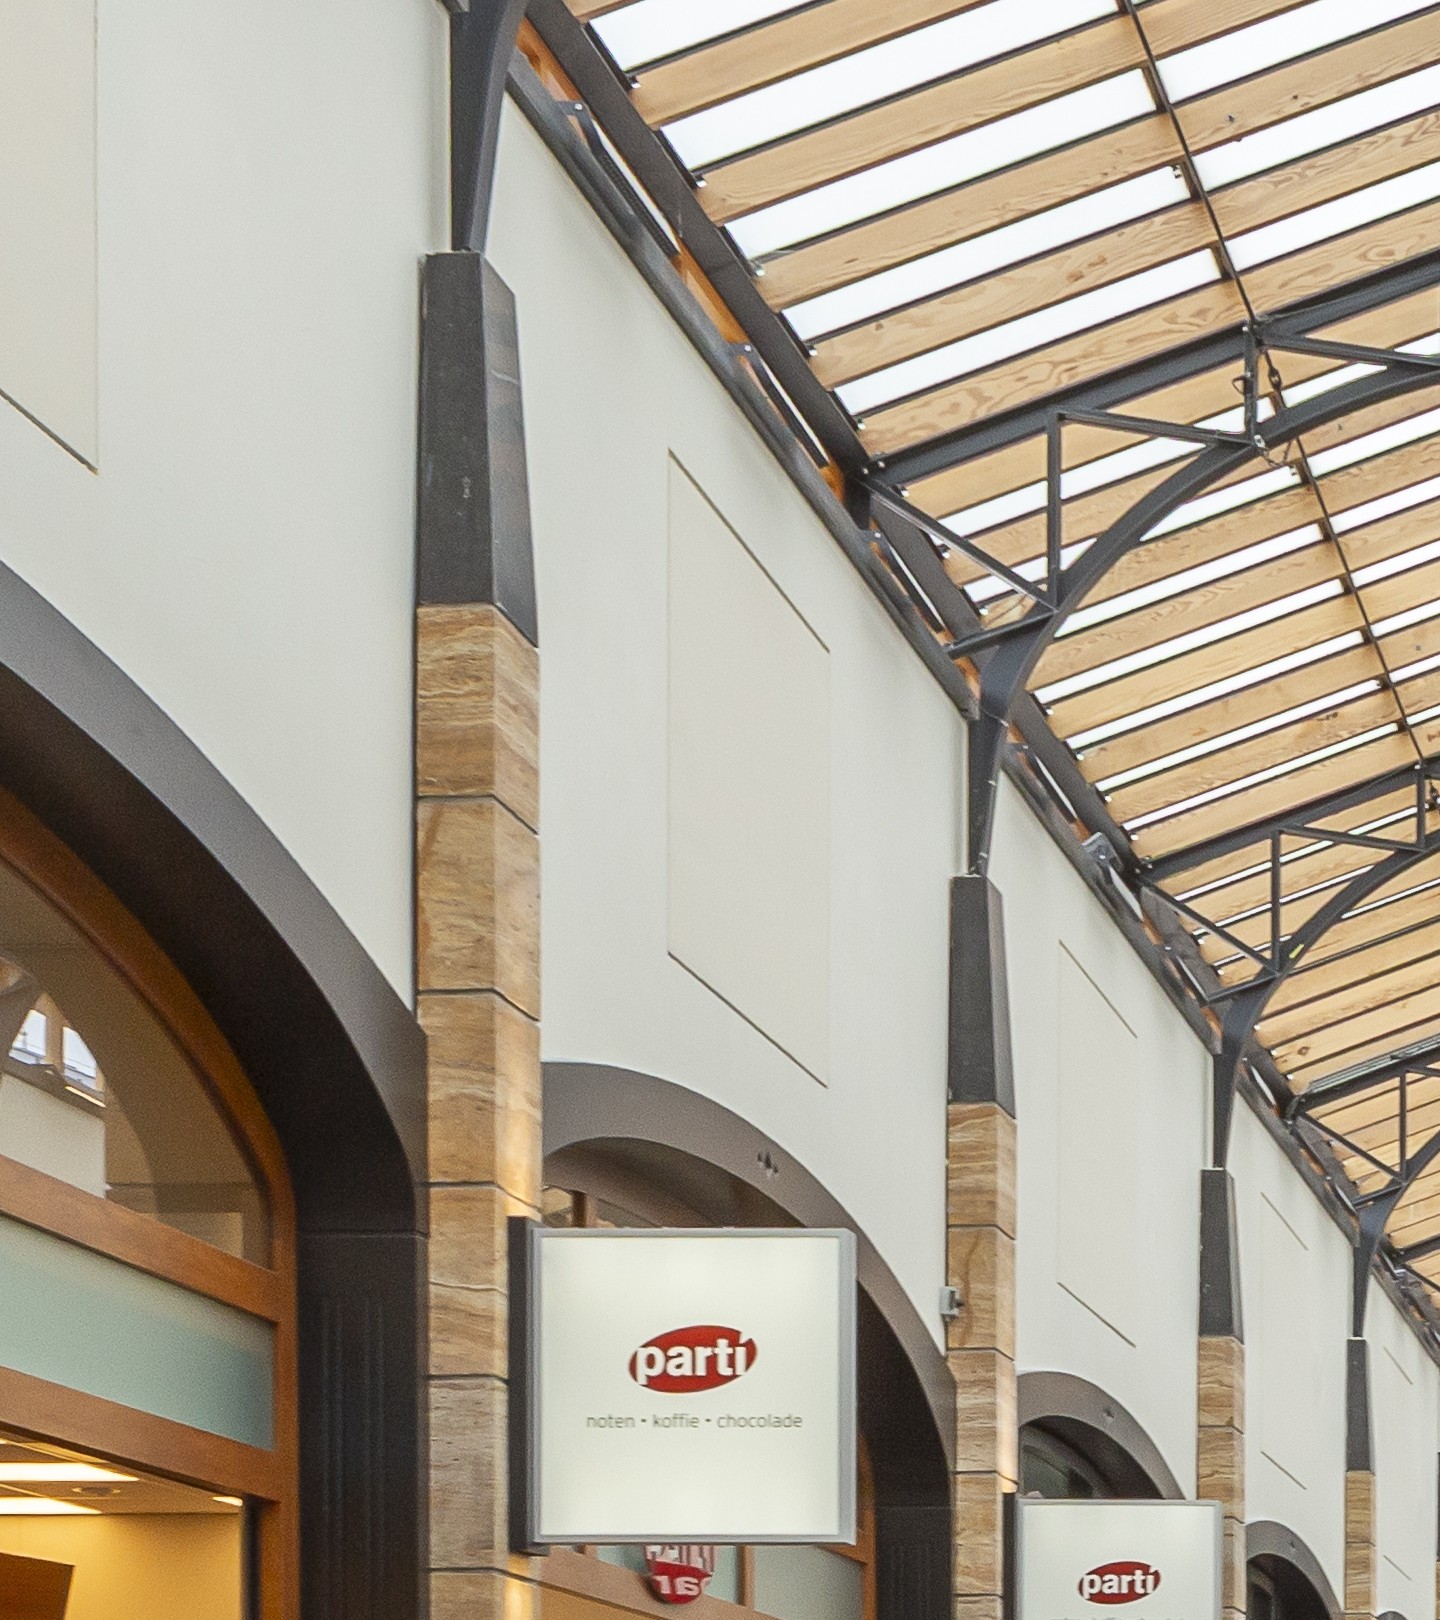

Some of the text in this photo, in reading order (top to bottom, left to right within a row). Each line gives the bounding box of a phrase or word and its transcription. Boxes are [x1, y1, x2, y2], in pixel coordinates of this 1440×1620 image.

[635, 1332, 753, 1386] parti
[586, 1413, 803, 1428] noten koffie chocolade
[1082, 1566, 1160, 1600] parti
